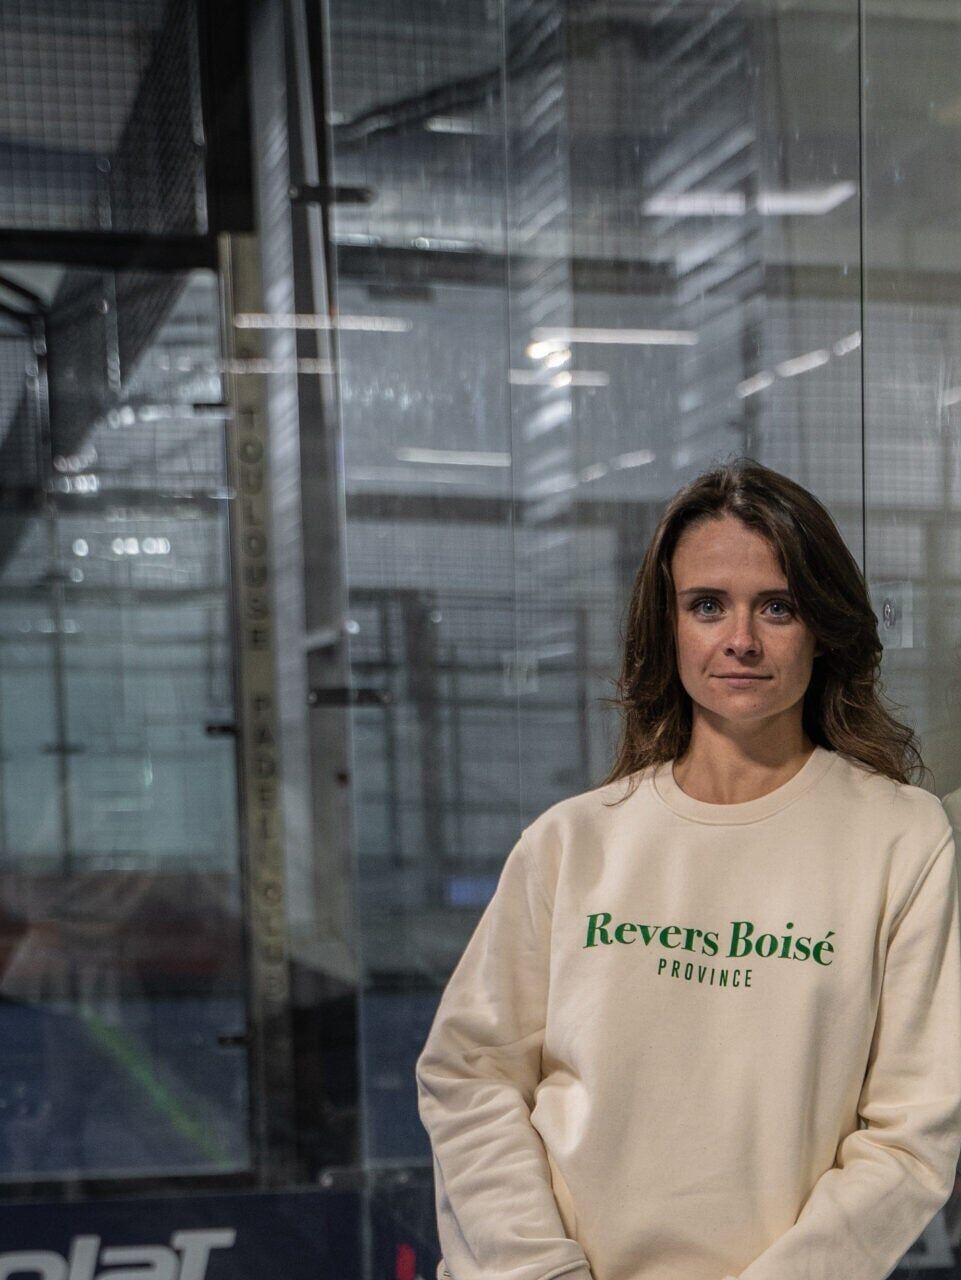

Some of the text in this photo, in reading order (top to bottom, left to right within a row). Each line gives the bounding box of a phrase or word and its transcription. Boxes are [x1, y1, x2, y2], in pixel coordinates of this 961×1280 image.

[583, 912, 836, 966] Revers Boisé
[657, 958, 753, 988] PROVINCE
